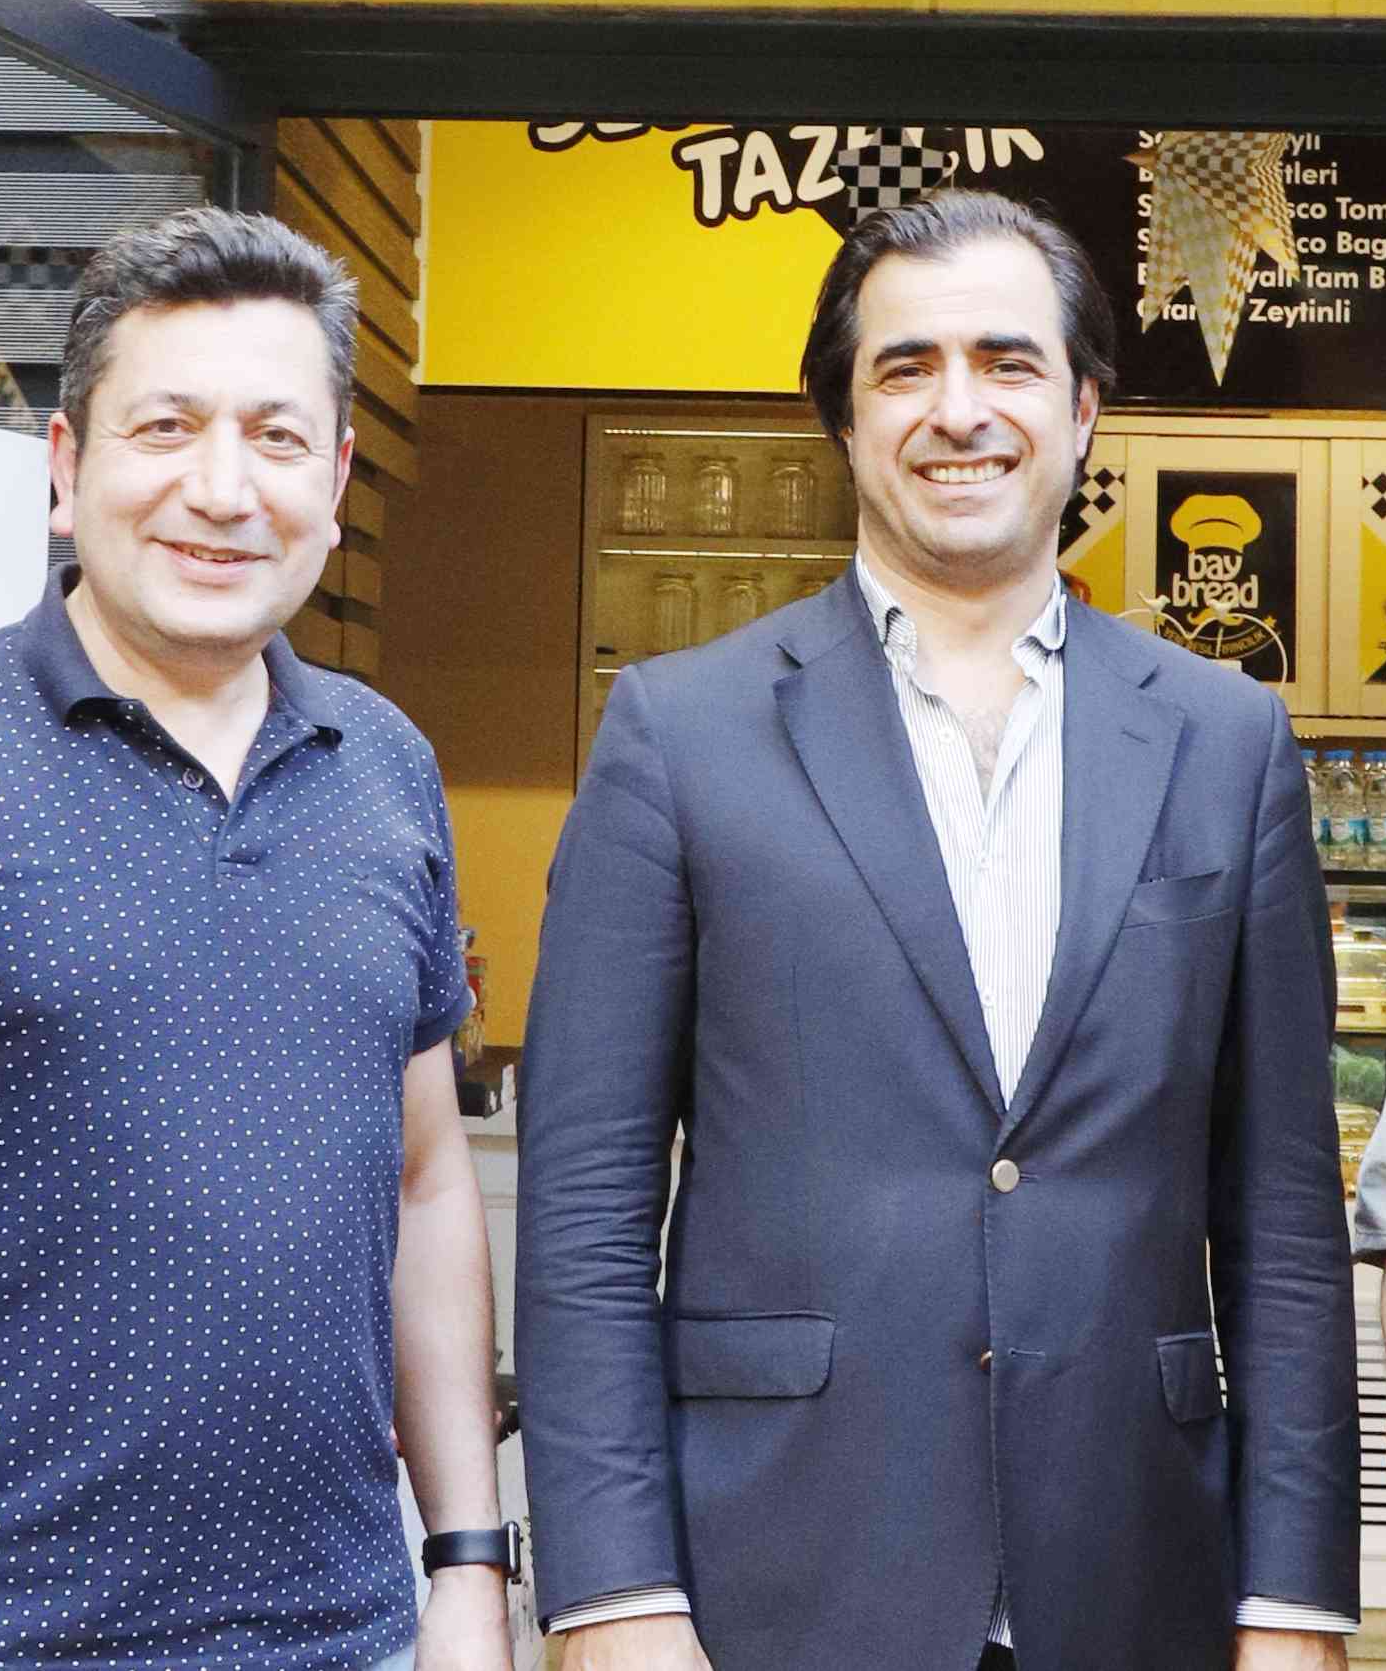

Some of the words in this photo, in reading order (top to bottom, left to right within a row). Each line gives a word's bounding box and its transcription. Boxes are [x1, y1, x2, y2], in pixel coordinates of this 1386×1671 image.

[1302, 265, 1359, 290] Tam
[1248, 298, 1352, 328] Zeytinli
[1188, 552, 1243, 582] bay
[1172, 572, 1259, 609] bread
